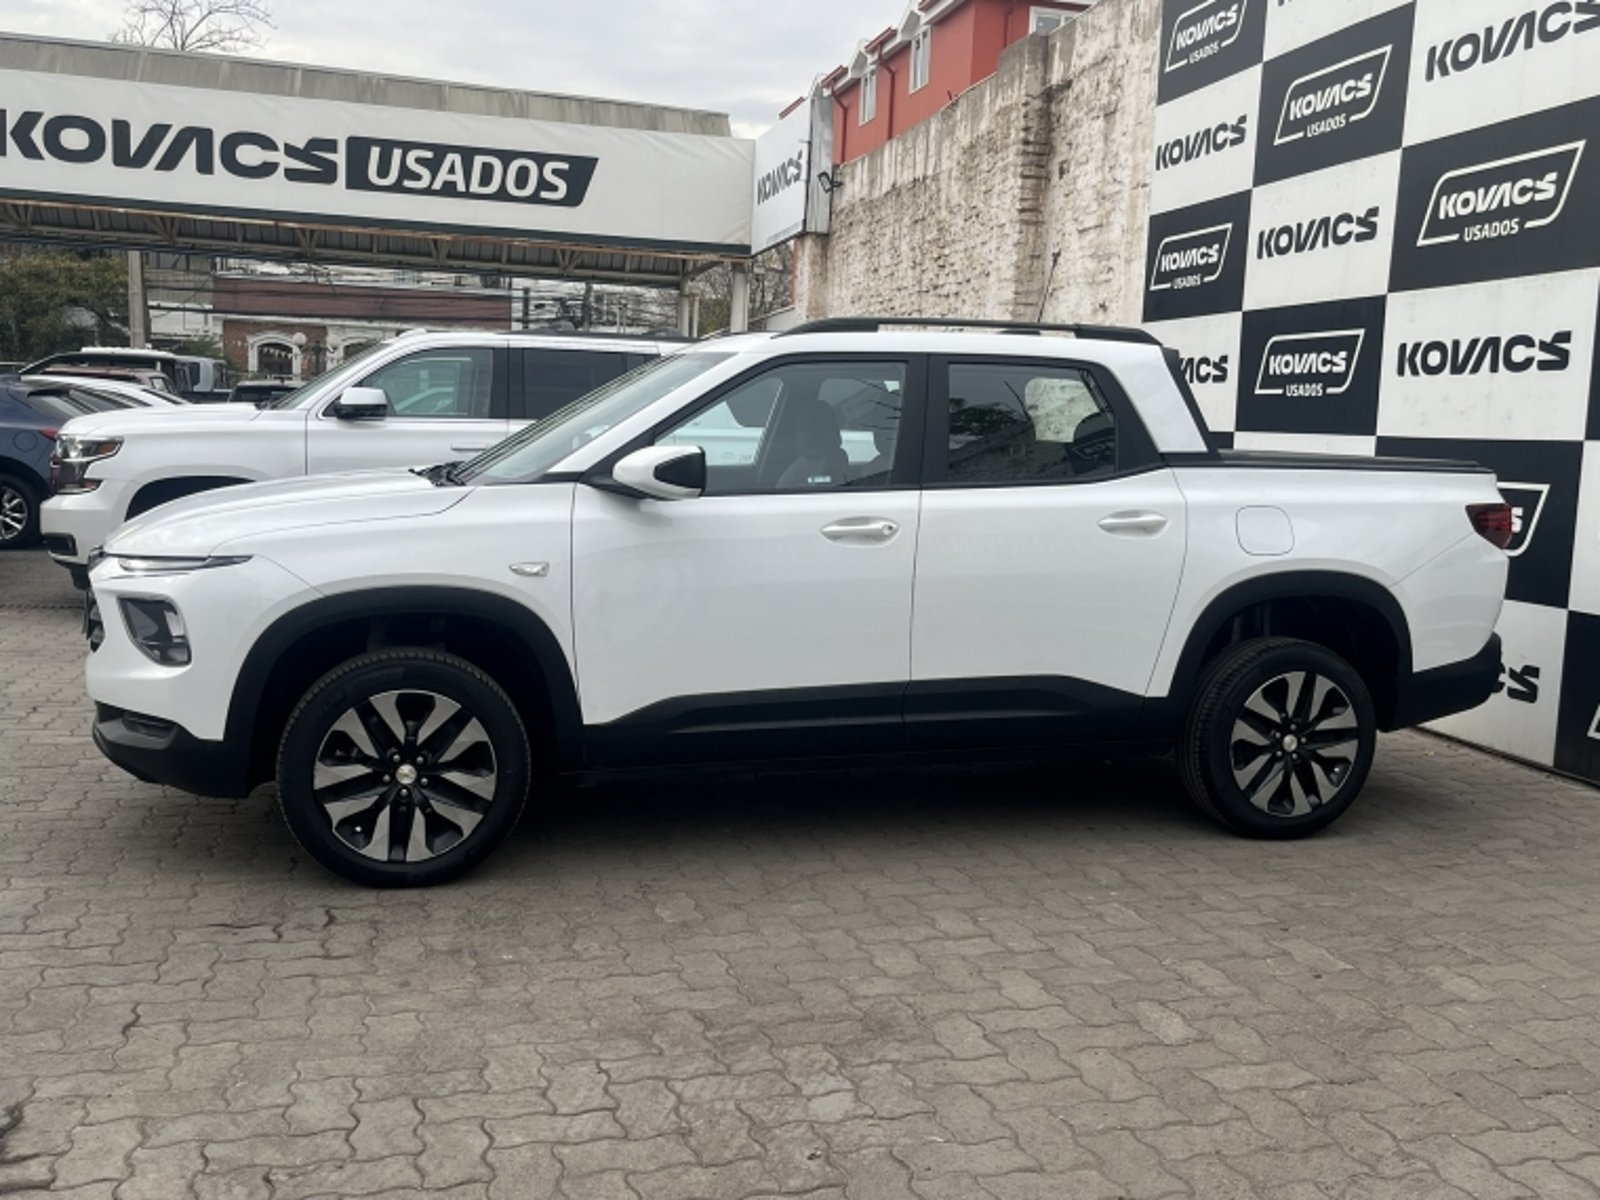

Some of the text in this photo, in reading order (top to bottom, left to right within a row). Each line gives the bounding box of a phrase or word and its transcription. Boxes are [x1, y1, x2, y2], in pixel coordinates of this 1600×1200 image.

[1176, 3, 1240, 51] KOVACS
[1425, 0, 1600, 83] KOVACS
[1188, 40, 1220, 65] USADOS
[1288, 71, 1373, 121] KOVACS
[1155, 113, 1248, 172] KOVACS
[1306, 112, 1347, 139] USADOS
[0, 108, 571, 200] KOVACS USADOS
[1438, 171, 1558, 220] KOVACS
[1256, 206, 1380, 260] KOVACS
[1463, 217, 1520, 243] USADOS
[1160, 243, 1220, 273] KOVACS
[1173, 273, 1201, 290] USADOS
[1268, 350, 1348, 376] KOVACS
[1396, 330, 1572, 377] KOVACS
[1285, 382, 1323, 397] USADOS
